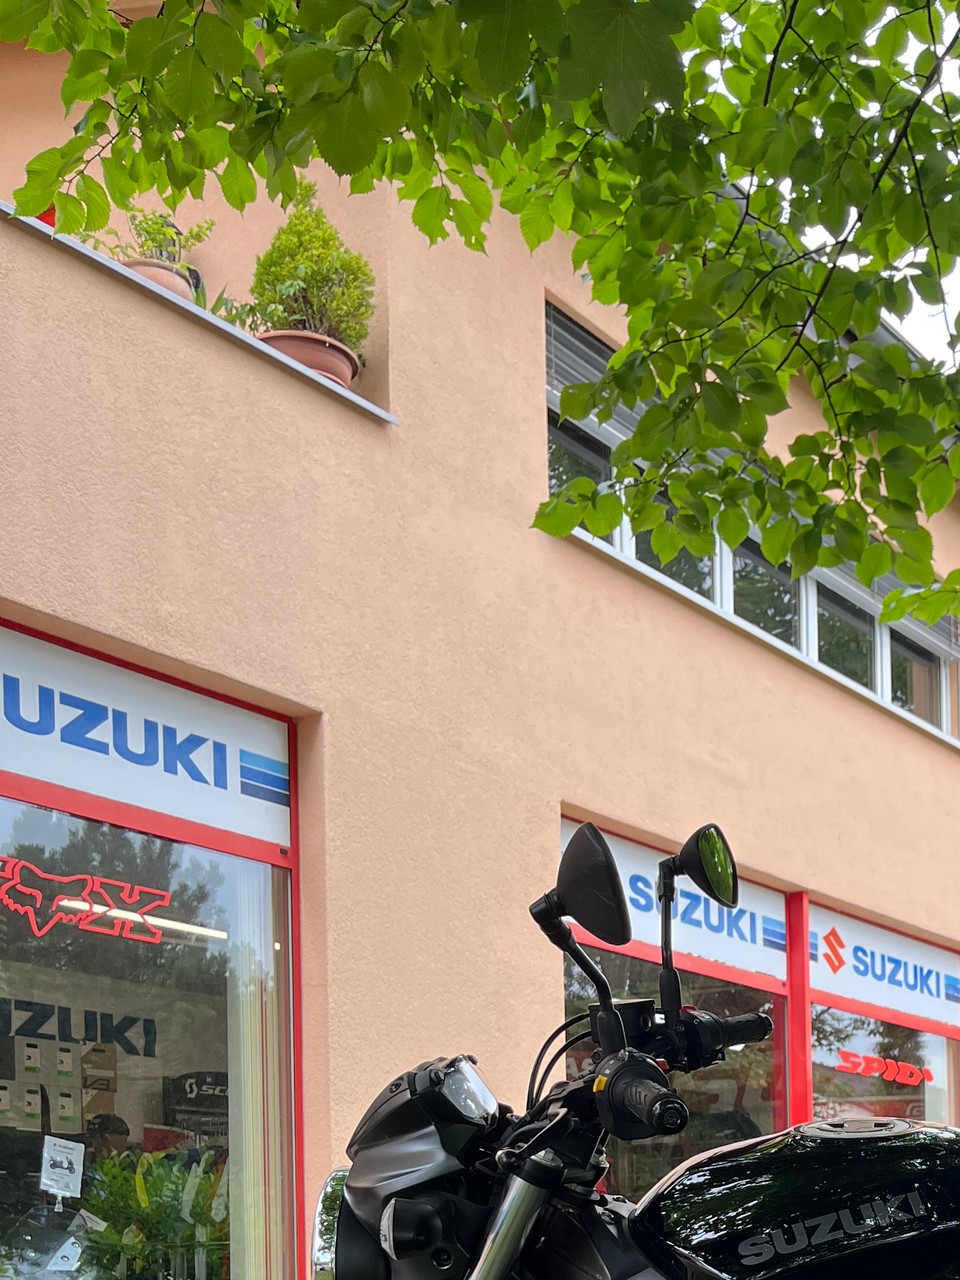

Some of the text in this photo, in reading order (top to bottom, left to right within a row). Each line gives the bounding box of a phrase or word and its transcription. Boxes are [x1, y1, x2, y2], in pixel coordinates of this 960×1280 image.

[852, 945, 941, 999] SUZUKI
[199, 1084, 229, 1096] SC
[737, 1190, 928, 1266] SUZUKI
